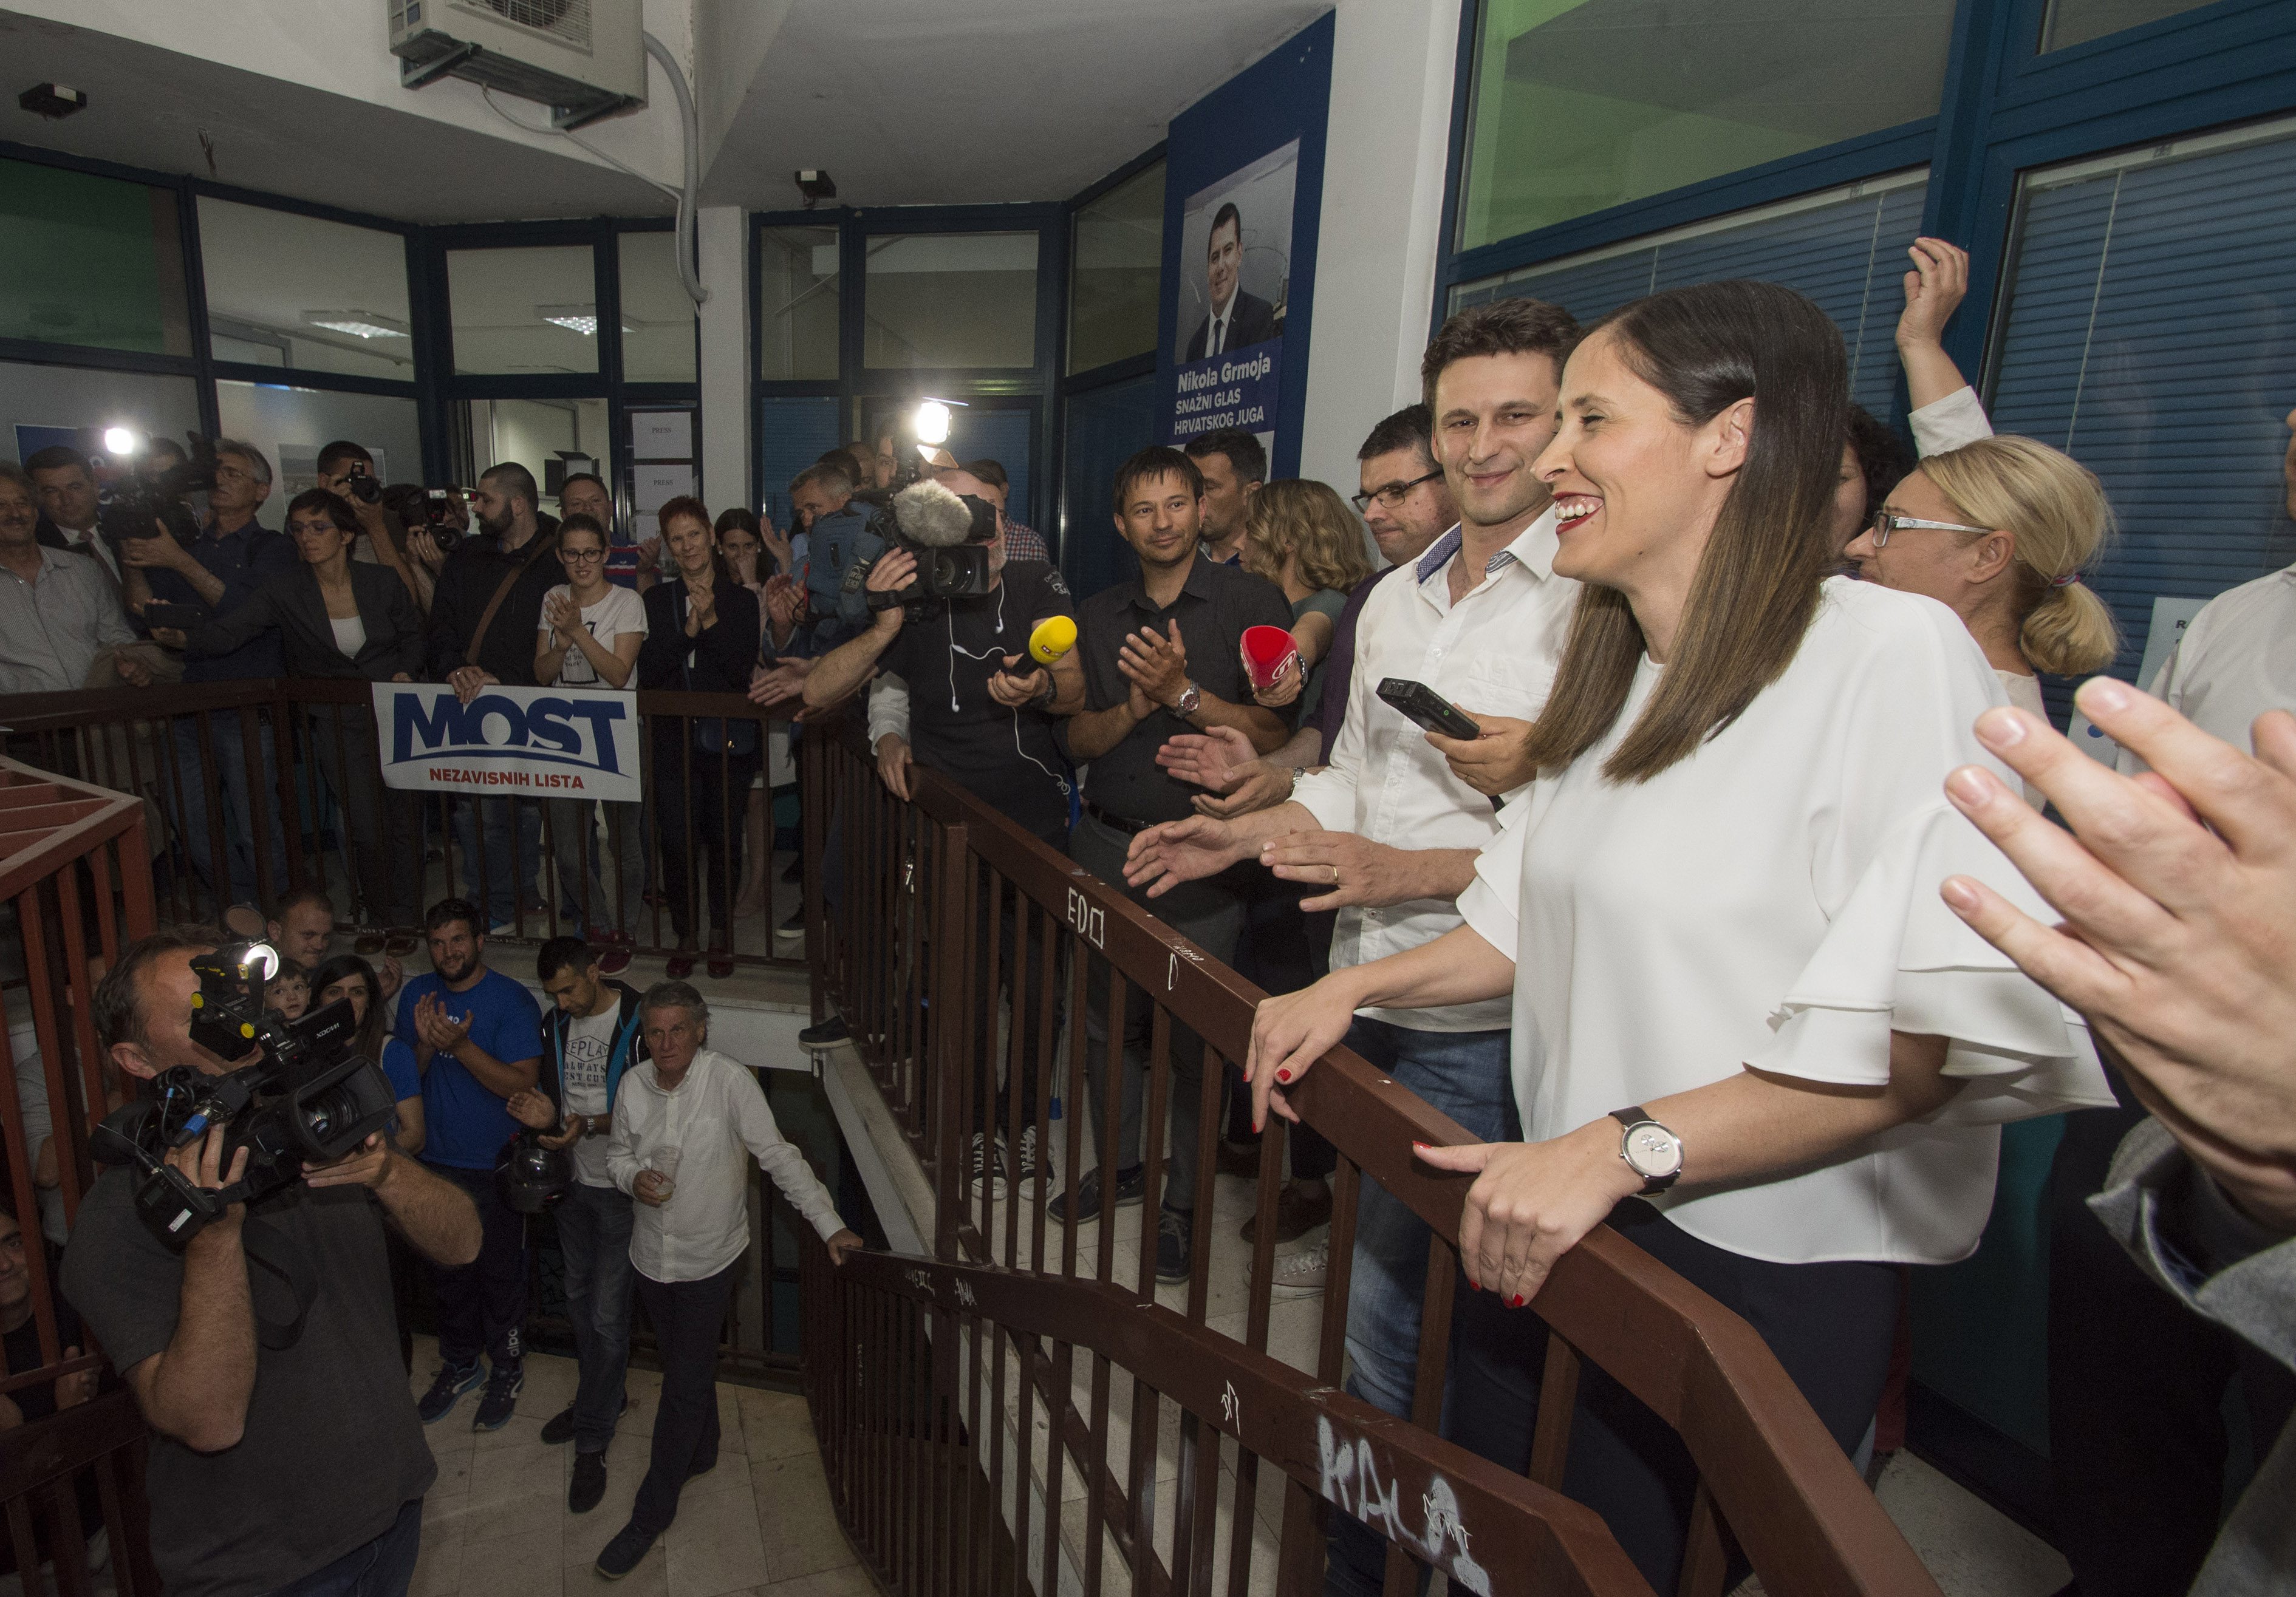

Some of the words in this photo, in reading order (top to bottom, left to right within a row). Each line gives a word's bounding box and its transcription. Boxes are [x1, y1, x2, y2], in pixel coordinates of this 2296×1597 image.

[1177, 367, 1218, 393] Nikola
[1221, 352, 1271, 383] Grmoja
[1175, 392, 1212, 415] SNAŽNI
[1214, 387, 1241, 408] GLAS
[1174, 411, 1234, 435] HRVATSKOG
[1235, 406, 1264, 426] JUGA
[392, 692, 626, 774] MOST
[429, 768, 530, 786] NEZAVISNIH
[535, 774, 584, 789] LISTA
[316, 1023, 340, 1039] XDCAM
